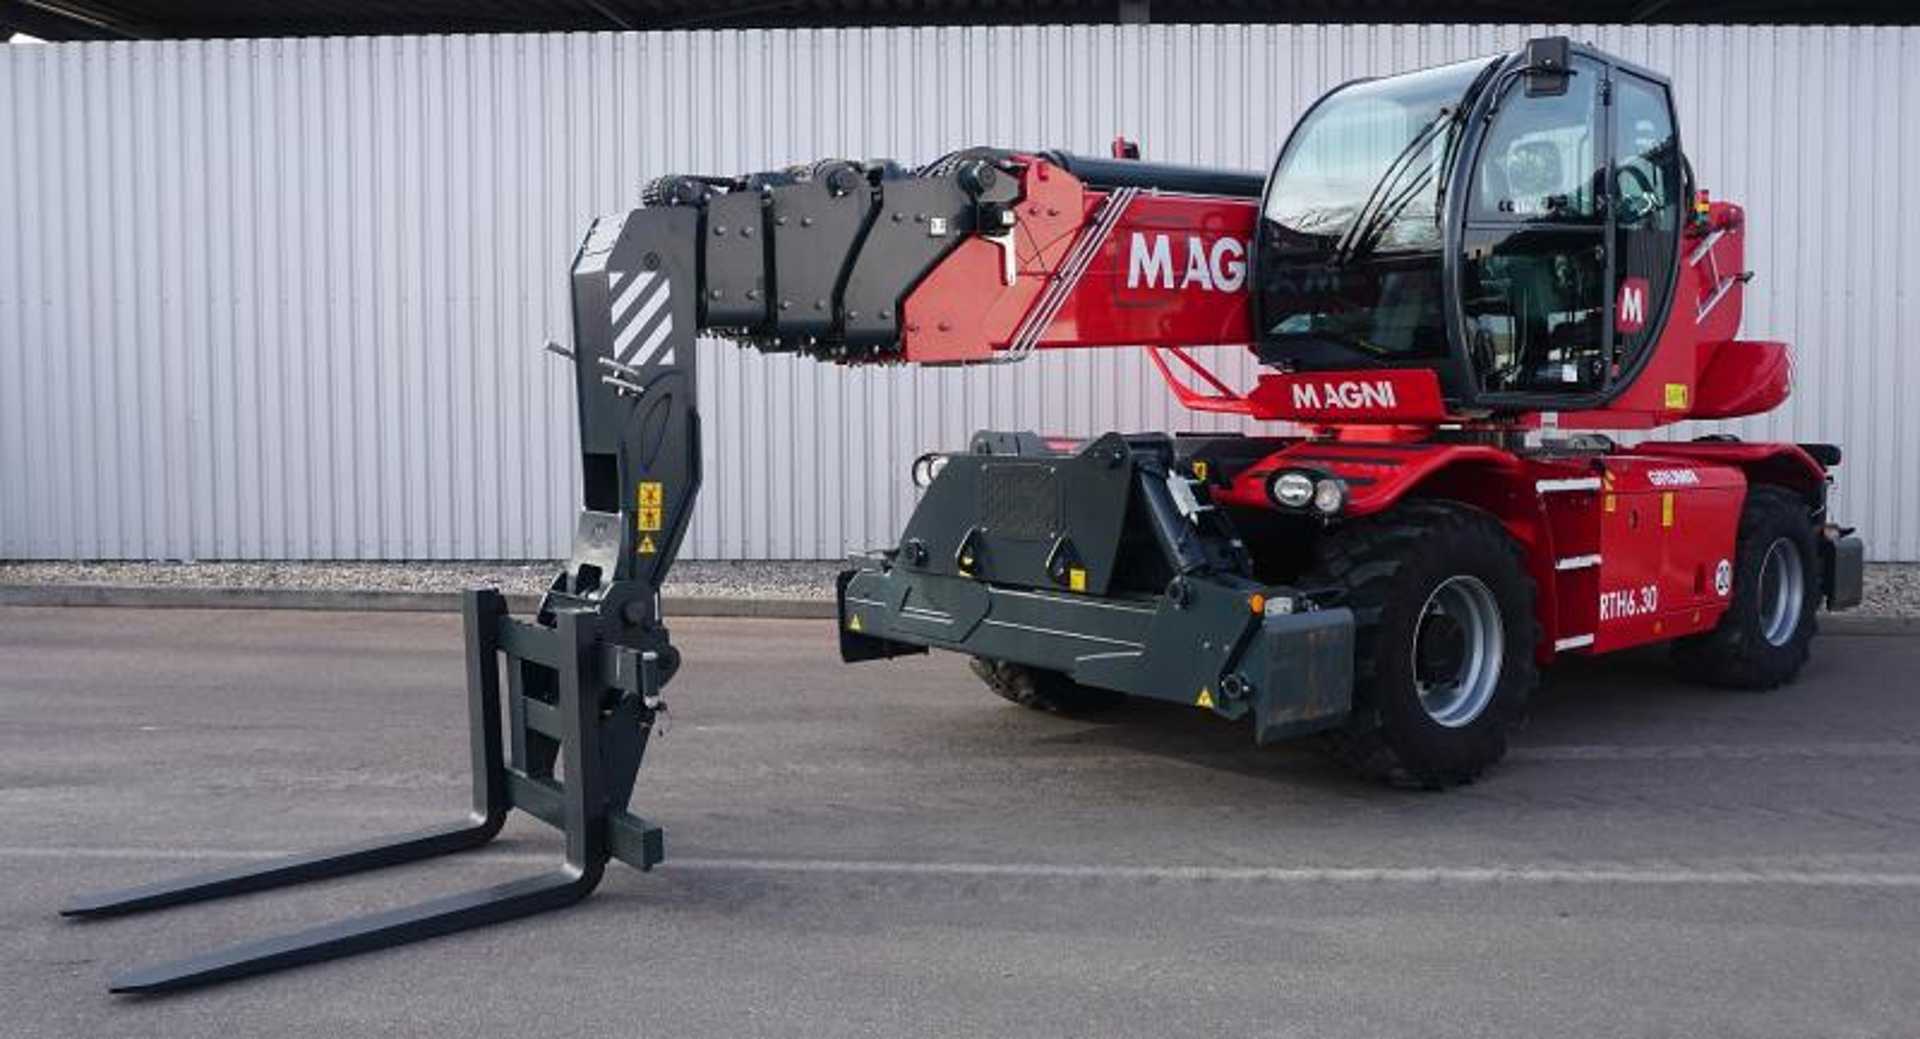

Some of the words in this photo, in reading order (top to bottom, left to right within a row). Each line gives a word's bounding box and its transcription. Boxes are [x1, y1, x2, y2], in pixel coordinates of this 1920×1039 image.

[1127, 231, 1252, 294] MAG
[1622, 287, 1643, 323] M
[1292, 380, 1396, 409] MAGNI
[1600, 585, 1657, 620] RTH6.30
